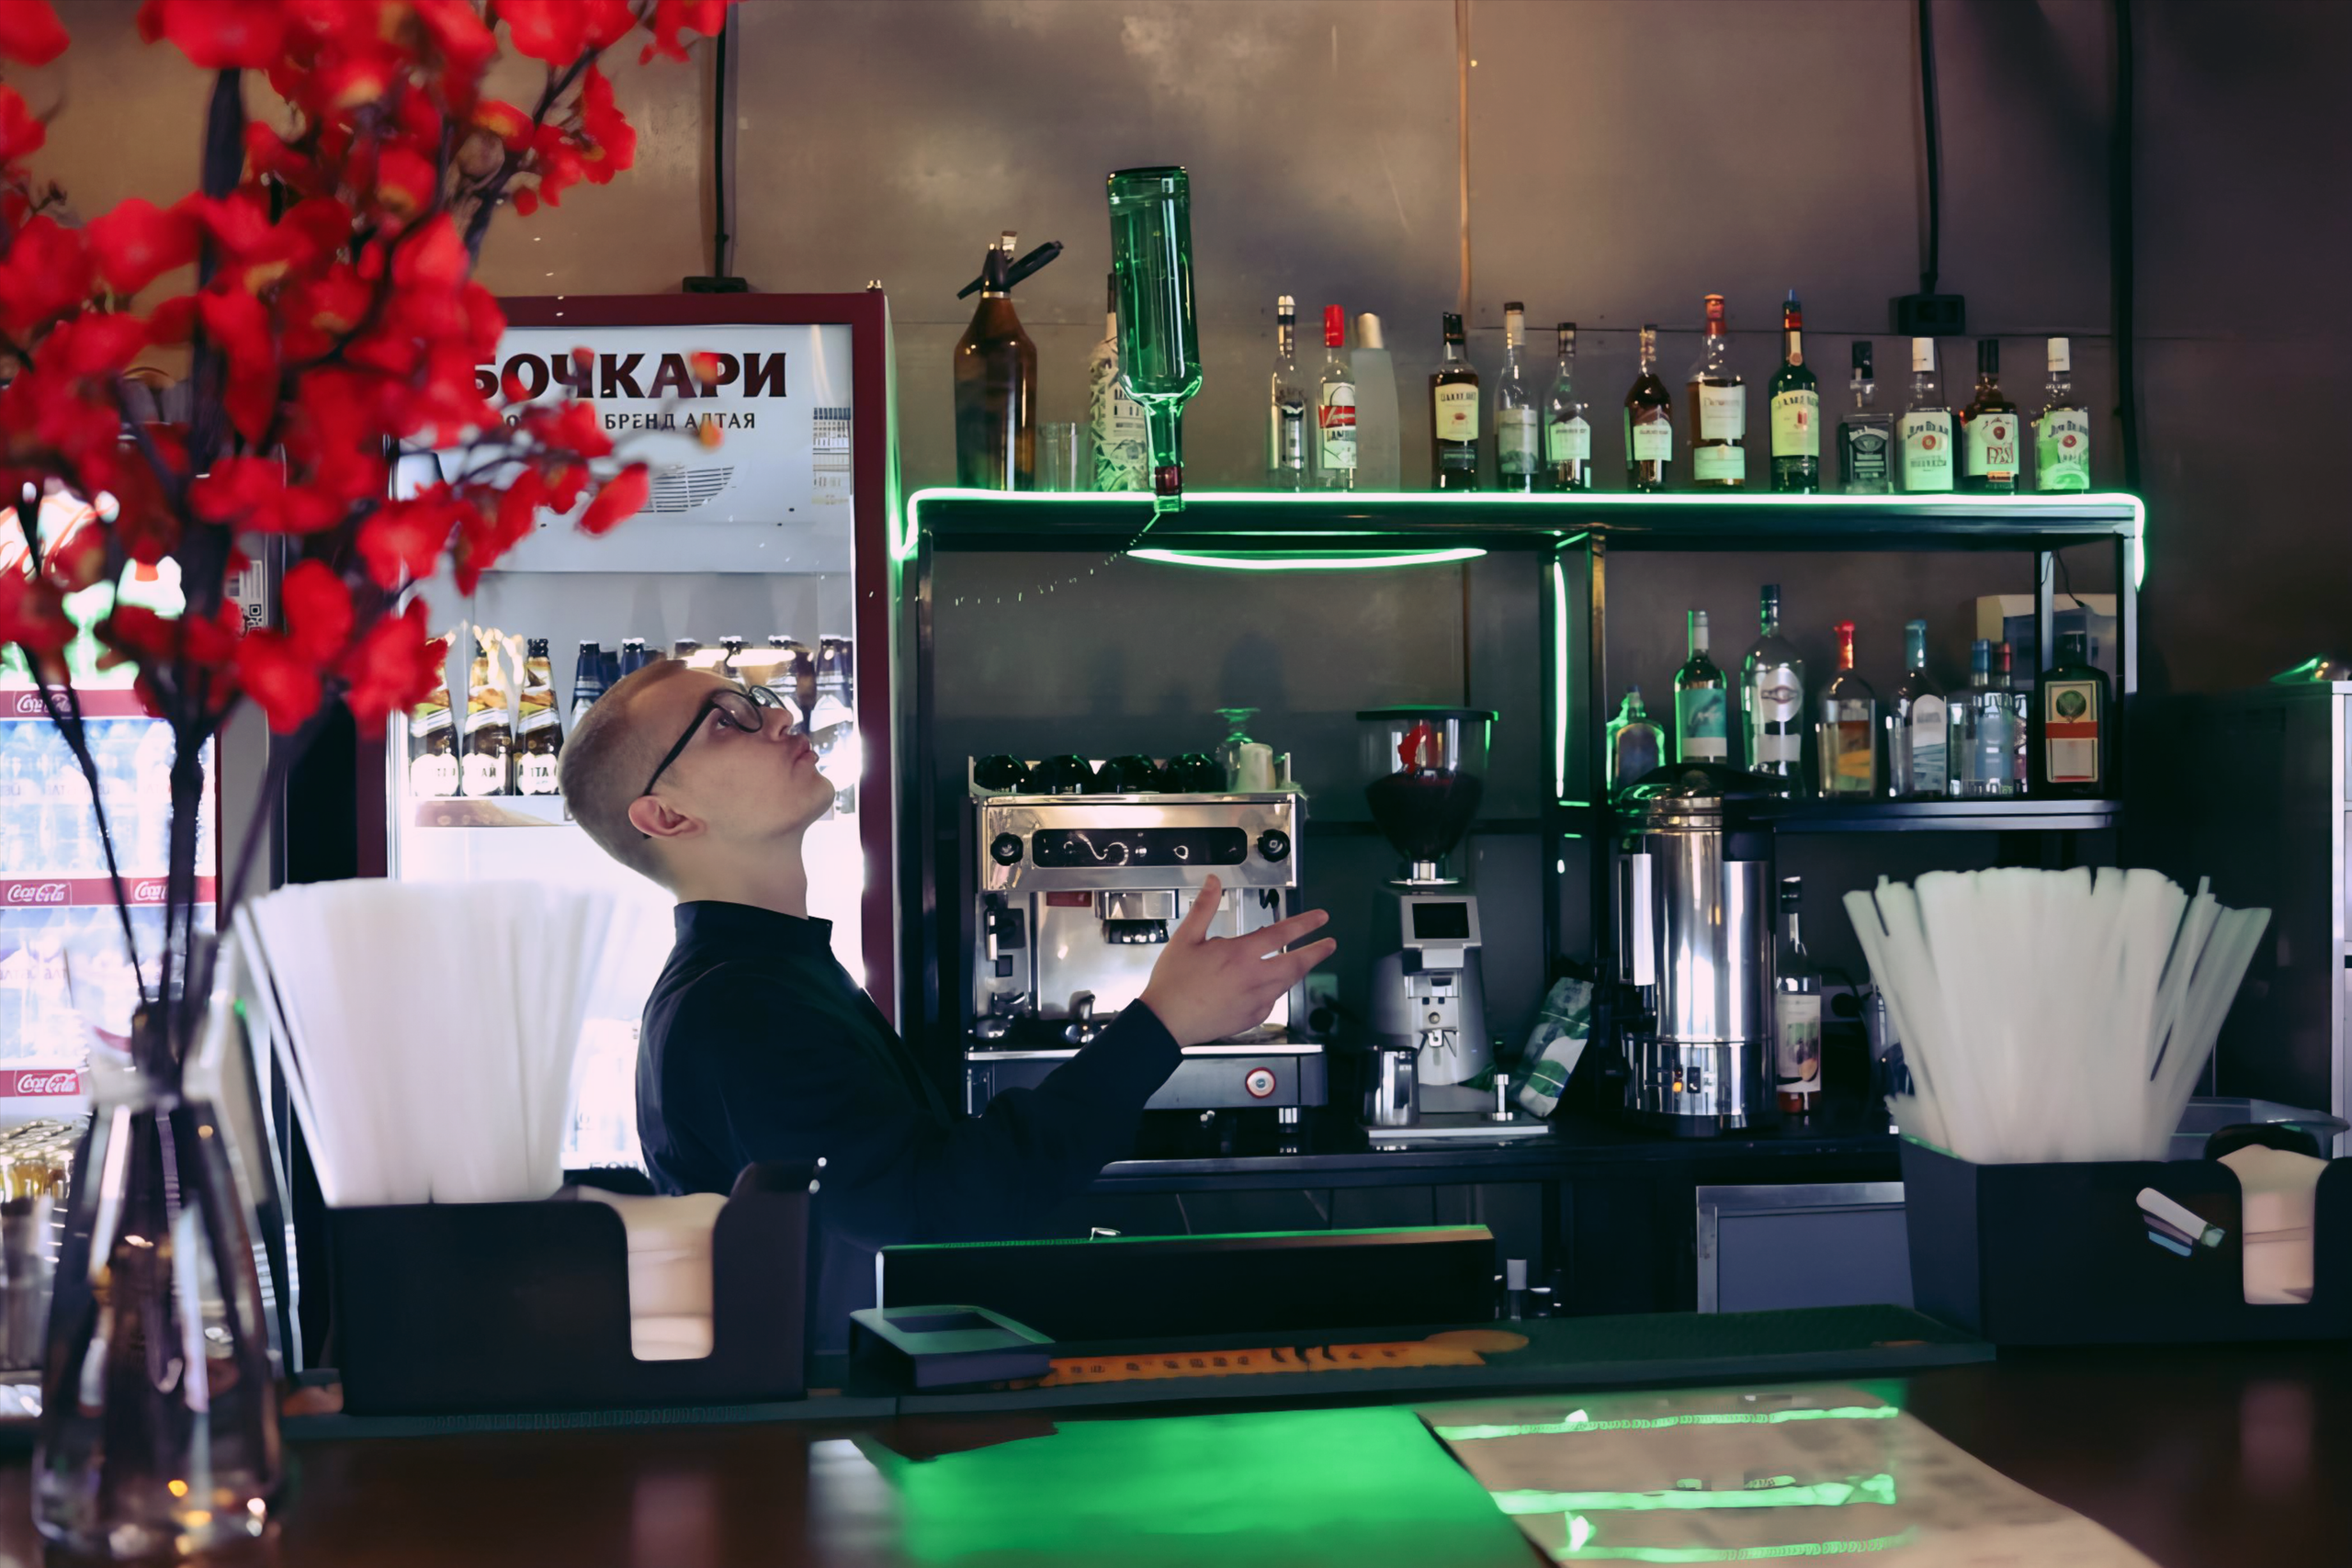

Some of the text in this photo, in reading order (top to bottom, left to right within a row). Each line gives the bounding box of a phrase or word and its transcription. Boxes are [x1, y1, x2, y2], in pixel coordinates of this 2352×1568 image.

[475, 353, 787, 400] БОЧКАРИ
[605, 413, 676, 432] БРЕНД
[7, 883, 70, 902] Coca-Cola
[17, 1072, 76, 1093] Coca-Cola
